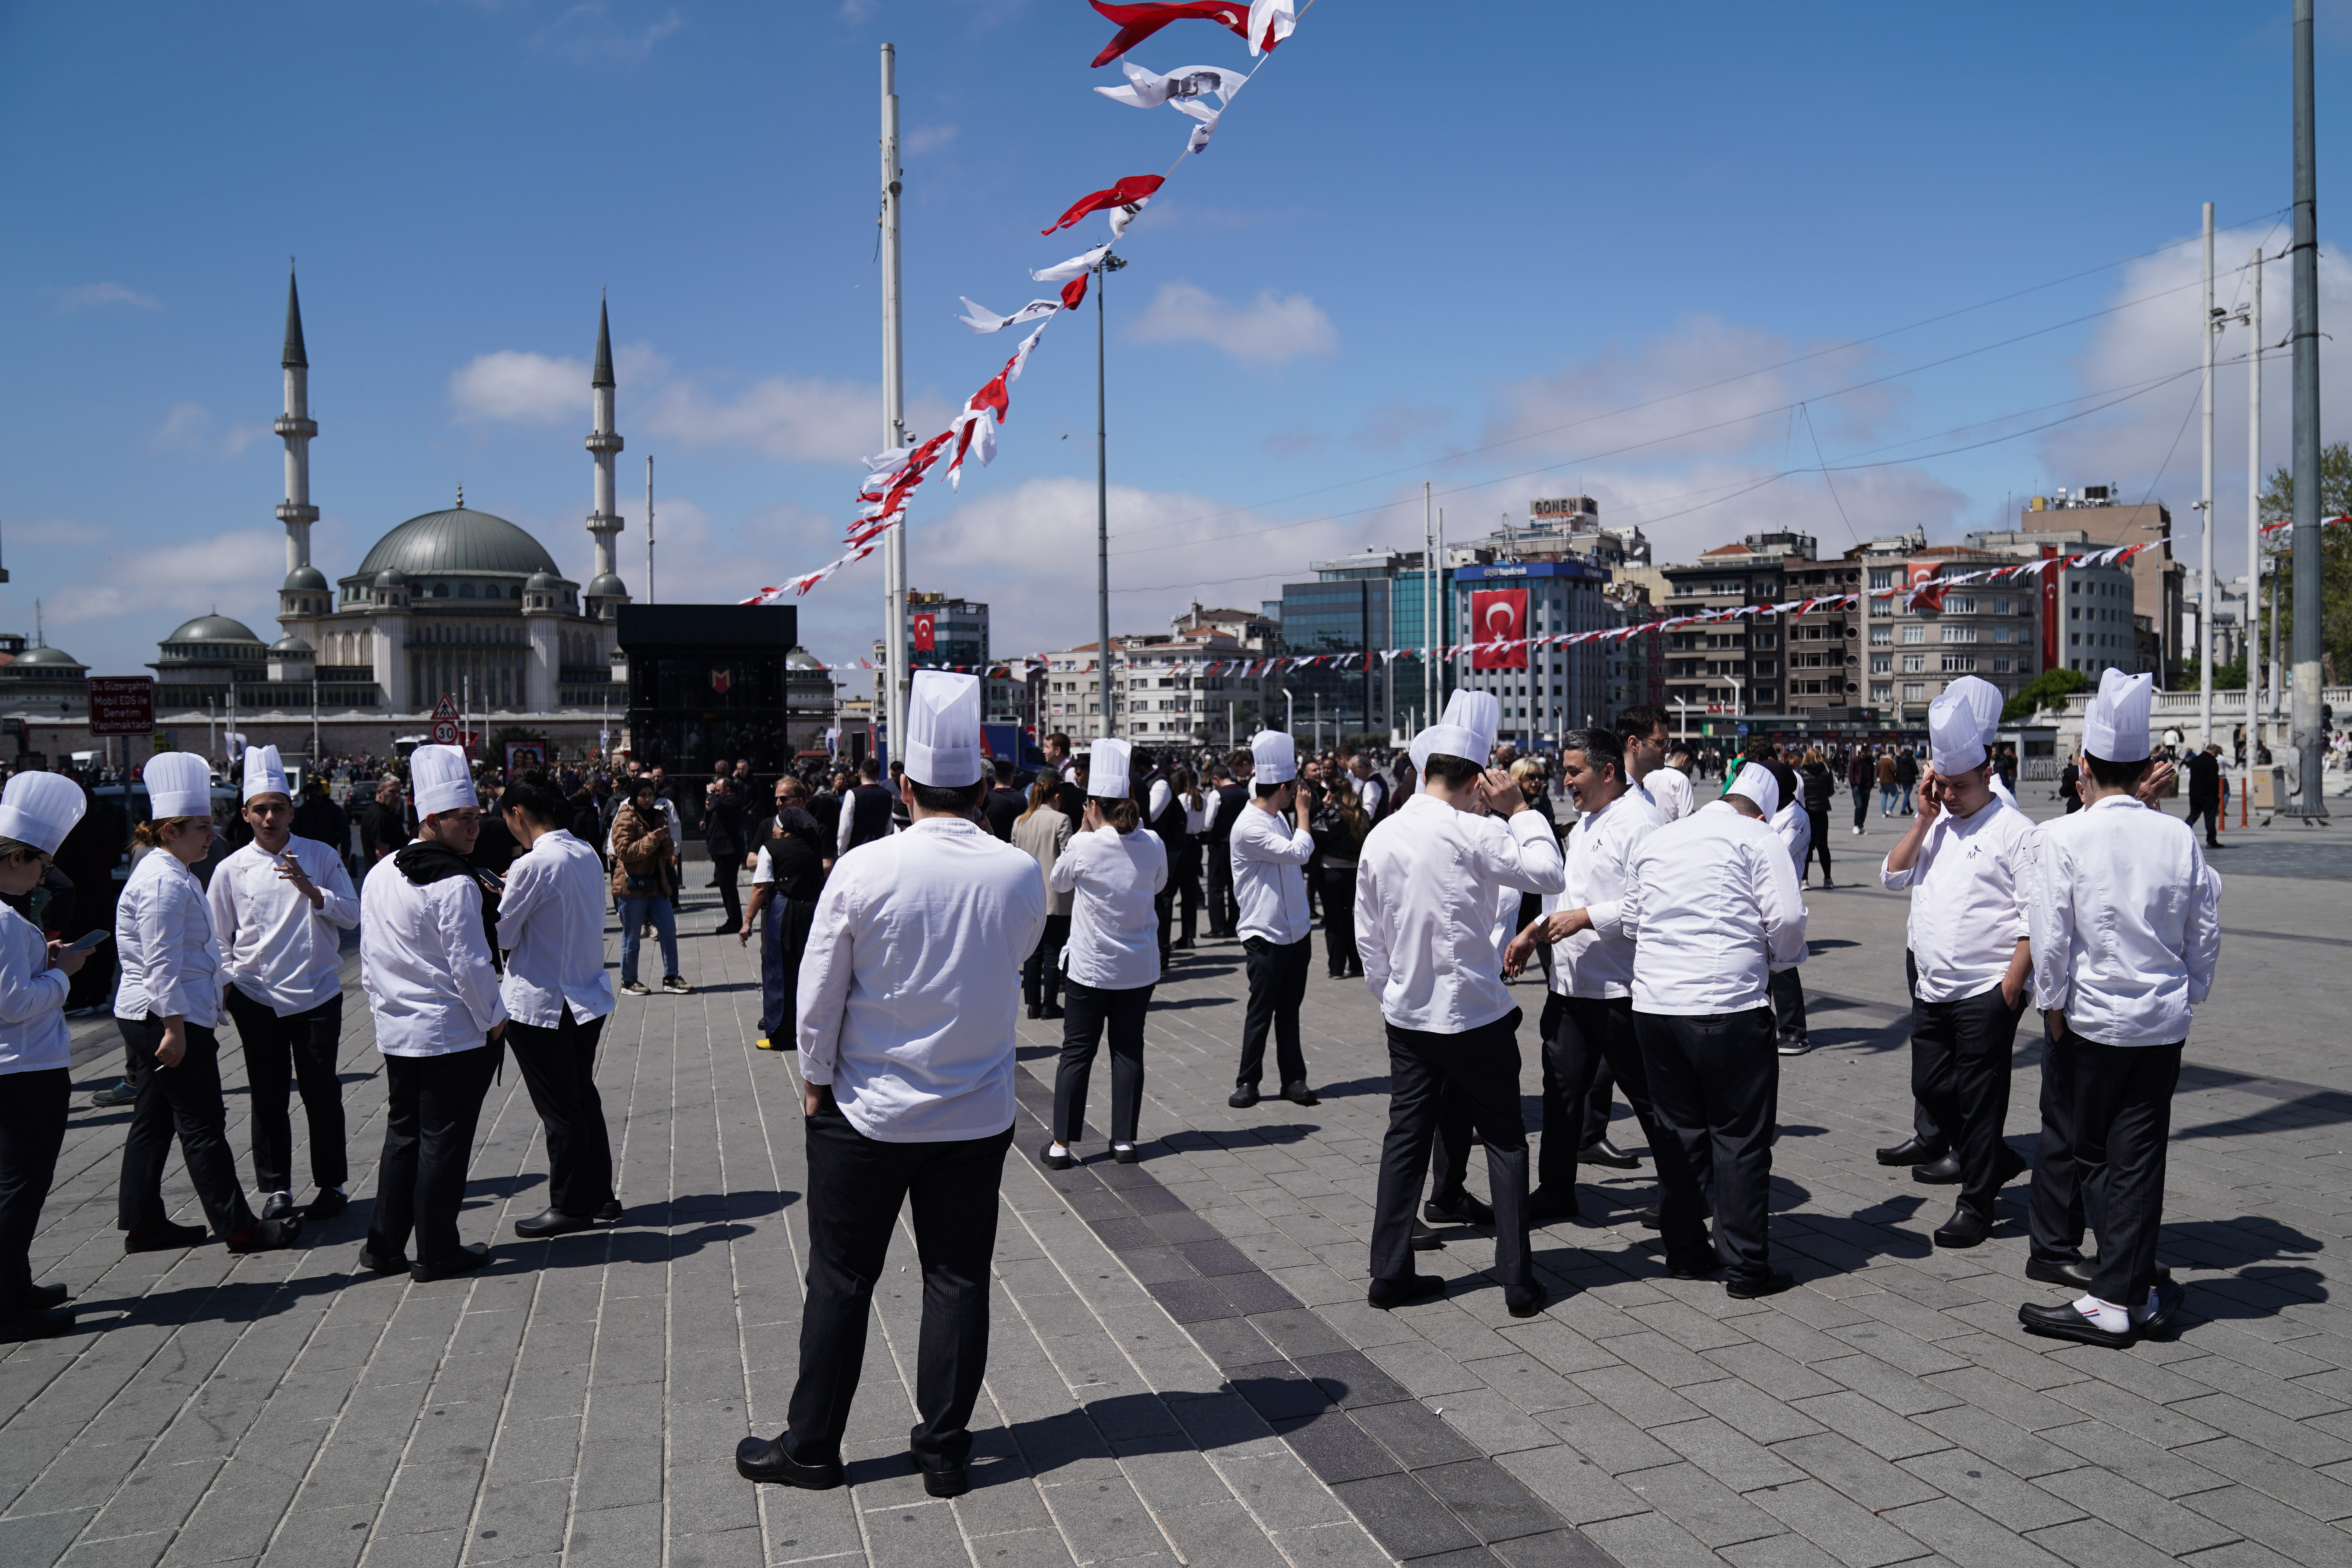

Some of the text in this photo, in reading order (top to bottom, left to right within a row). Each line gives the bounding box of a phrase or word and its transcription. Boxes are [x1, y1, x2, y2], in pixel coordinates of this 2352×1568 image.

[91, 681, 150, 693] Bu Güzergahta
[94, 695, 148, 705] Mobil EDS ile
[103, 708, 141, 718] Denetim
[93, 720, 151, 732] Yapılmaktadır
[438, 728, 454, 739] 30
[1590, 845, 1598, 853] M
[1966, 851, 1976, 859] M
